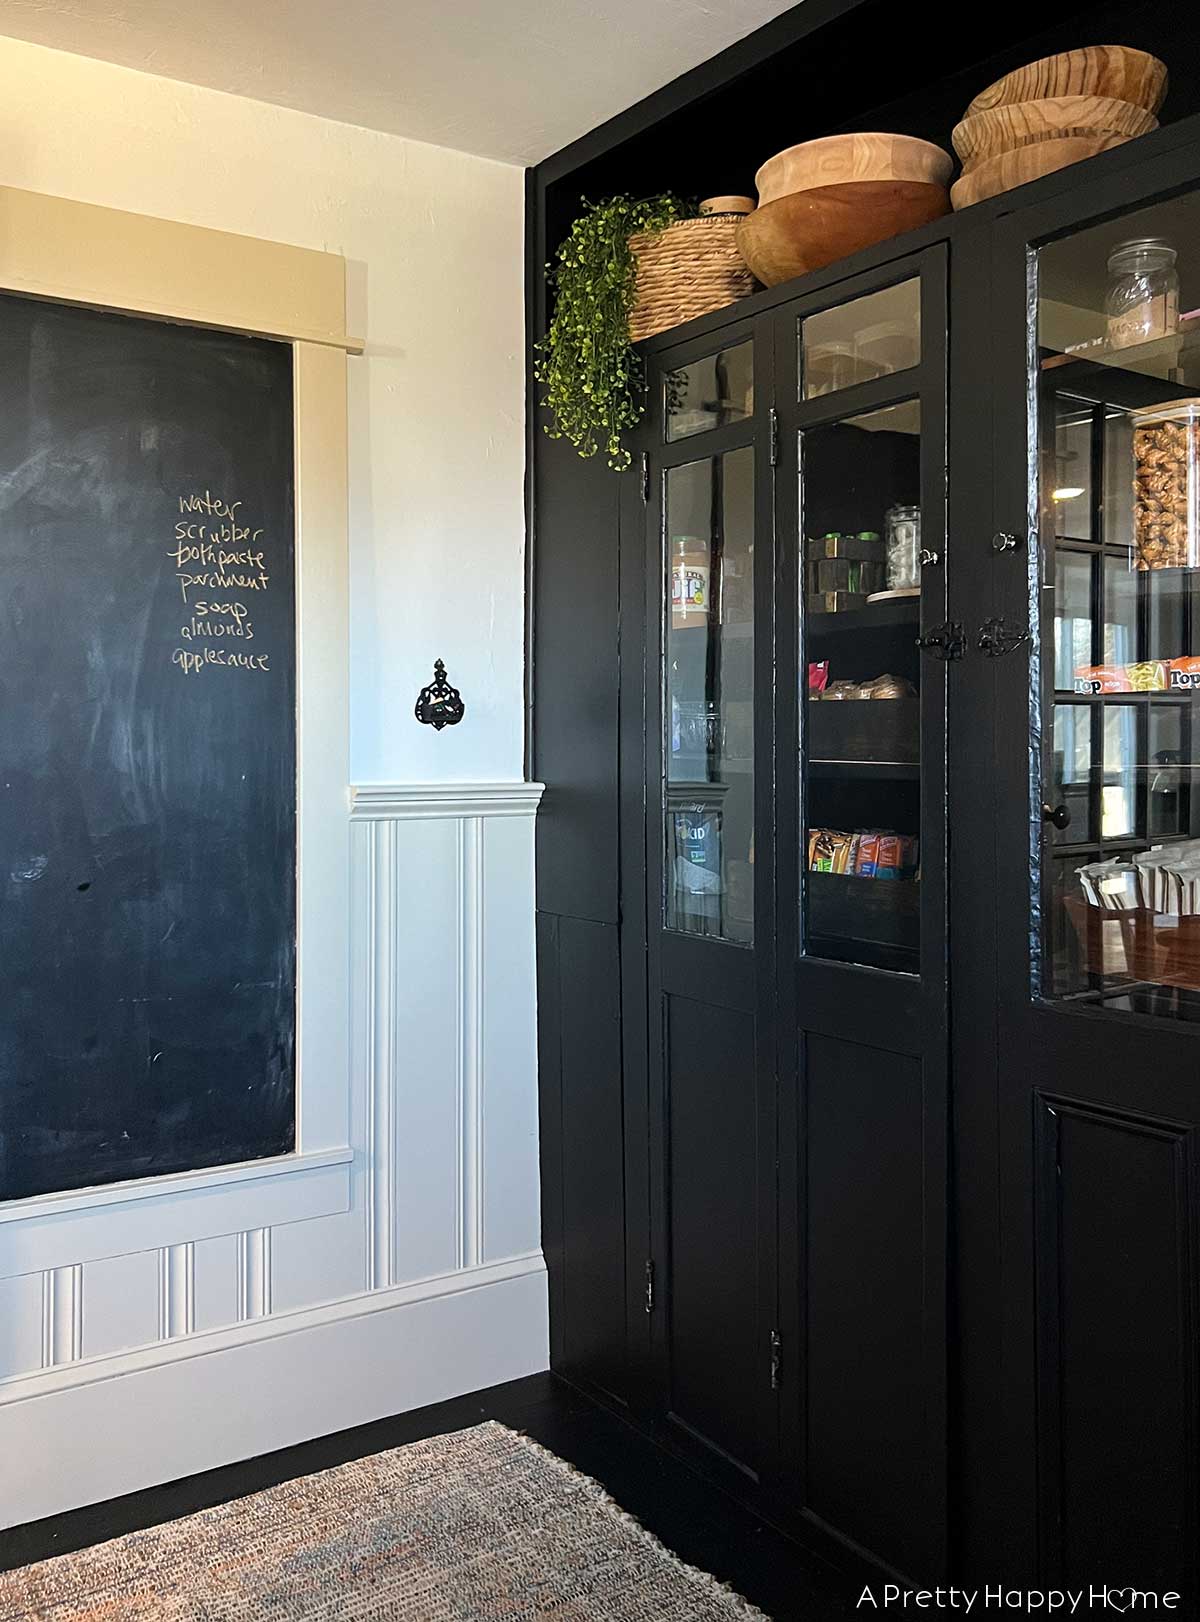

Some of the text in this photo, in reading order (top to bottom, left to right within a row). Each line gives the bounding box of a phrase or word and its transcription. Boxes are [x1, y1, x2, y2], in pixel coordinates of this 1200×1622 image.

[178, 490, 242, 521] water
[175, 521, 264, 547] scrubber
[175, 572, 269, 603] parchment
[195, 601, 247, 624] soap
[181, 617, 254, 640] almonds
[172, 647, 270, 674] applesauce
[1075, 678, 1102, 694] Top
